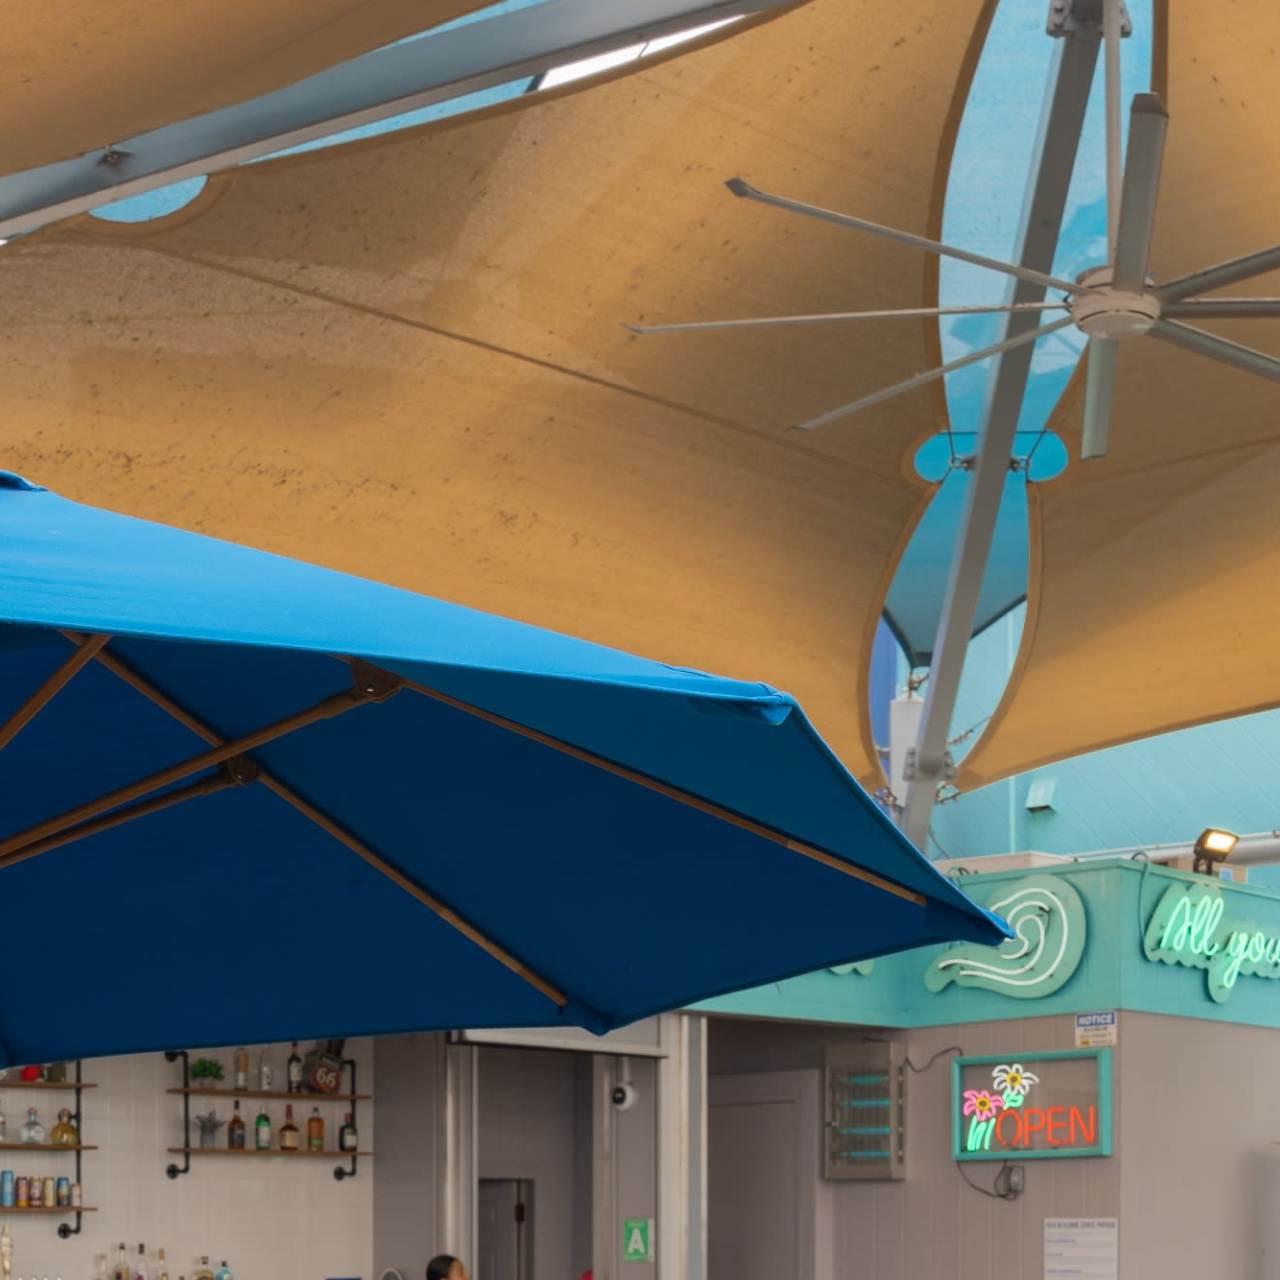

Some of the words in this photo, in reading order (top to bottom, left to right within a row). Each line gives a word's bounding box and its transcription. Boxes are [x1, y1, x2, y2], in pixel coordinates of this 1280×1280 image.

[1160, 895, 1224, 956] All
[316, 1067, 337, 1089] 66
[995, 1105, 1096, 1148] OPEN
[627, 1228, 646, 1254] A
